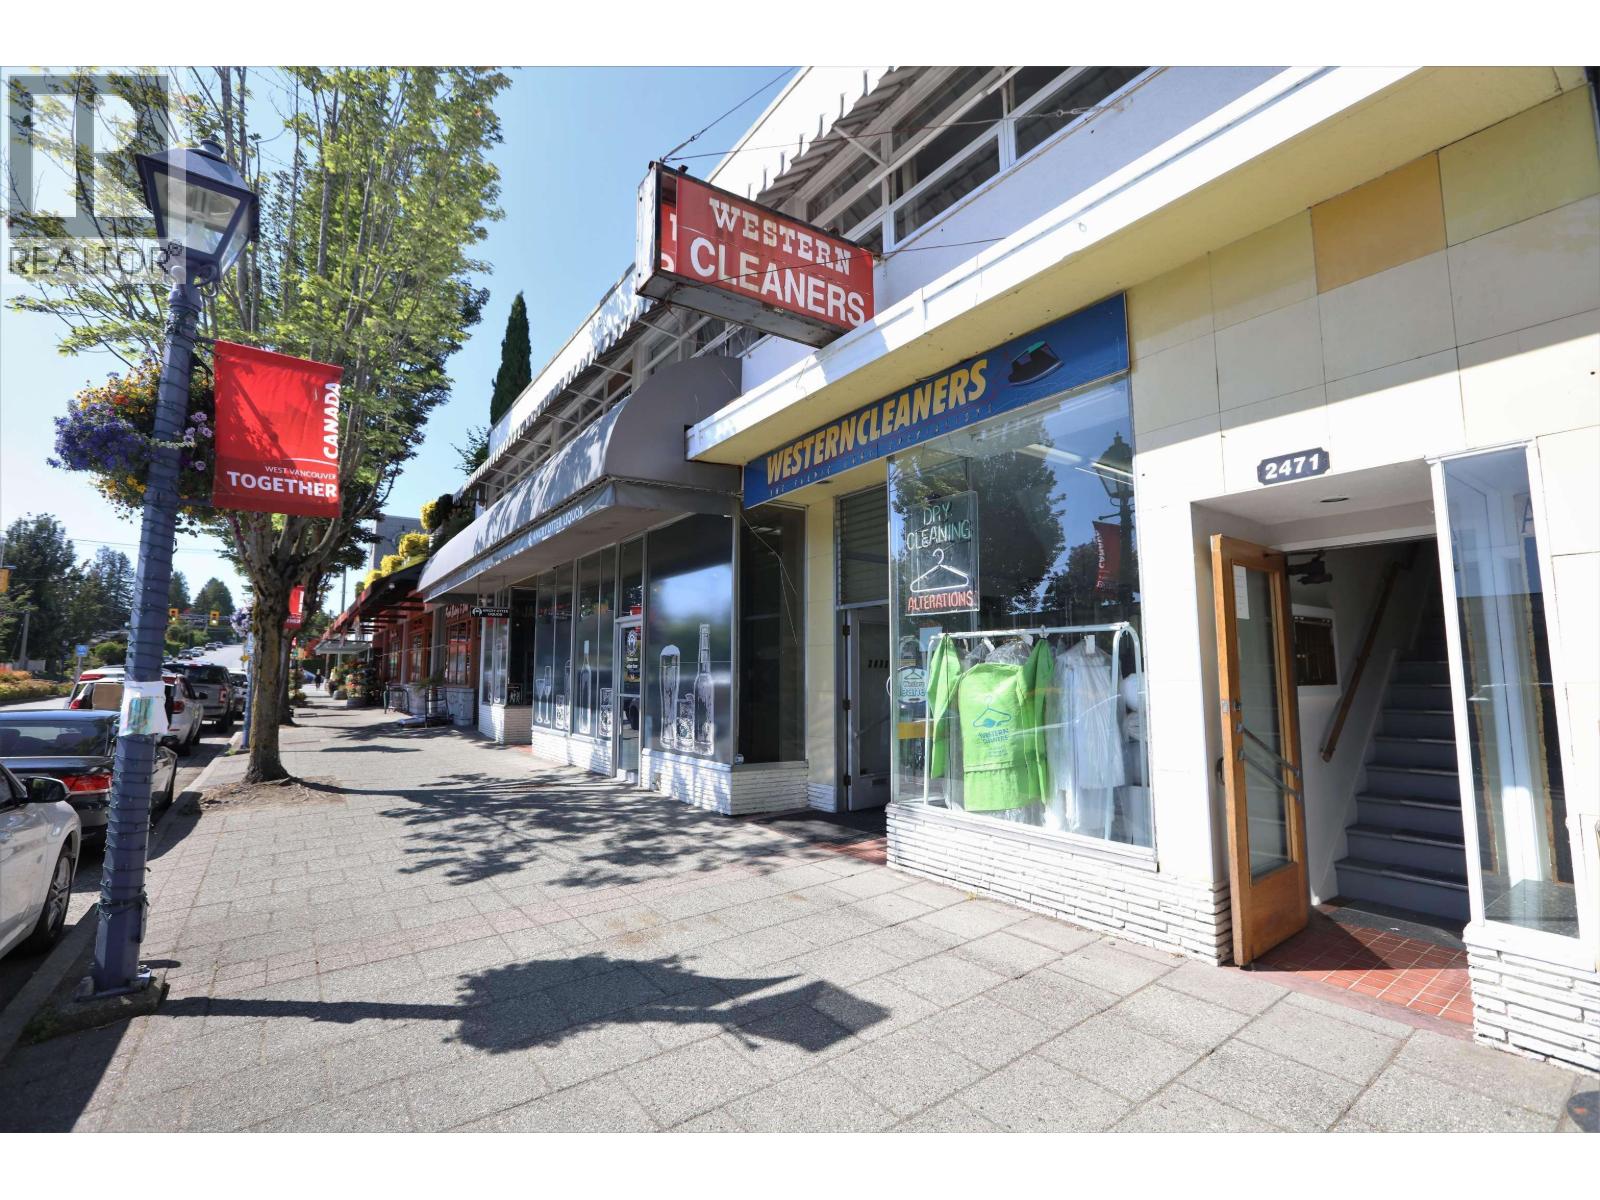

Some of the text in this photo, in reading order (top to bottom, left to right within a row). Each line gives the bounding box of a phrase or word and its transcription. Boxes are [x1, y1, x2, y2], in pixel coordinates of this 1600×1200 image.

[709, 197, 850, 275] WESTERN
[690, 236, 865, 327] CLEANERS
[323, 382, 341, 459] CANADA
[265, 465, 336, 480] WEST VANCOUVER
[1265, 453, 1320, 480] 2471
[226, 470, 337, 498] TOGETHER
[923, 501, 952, 526] DRY
[906, 519, 971, 551] CLEANING
[907, 590, 974, 612] ALTERATIONS
